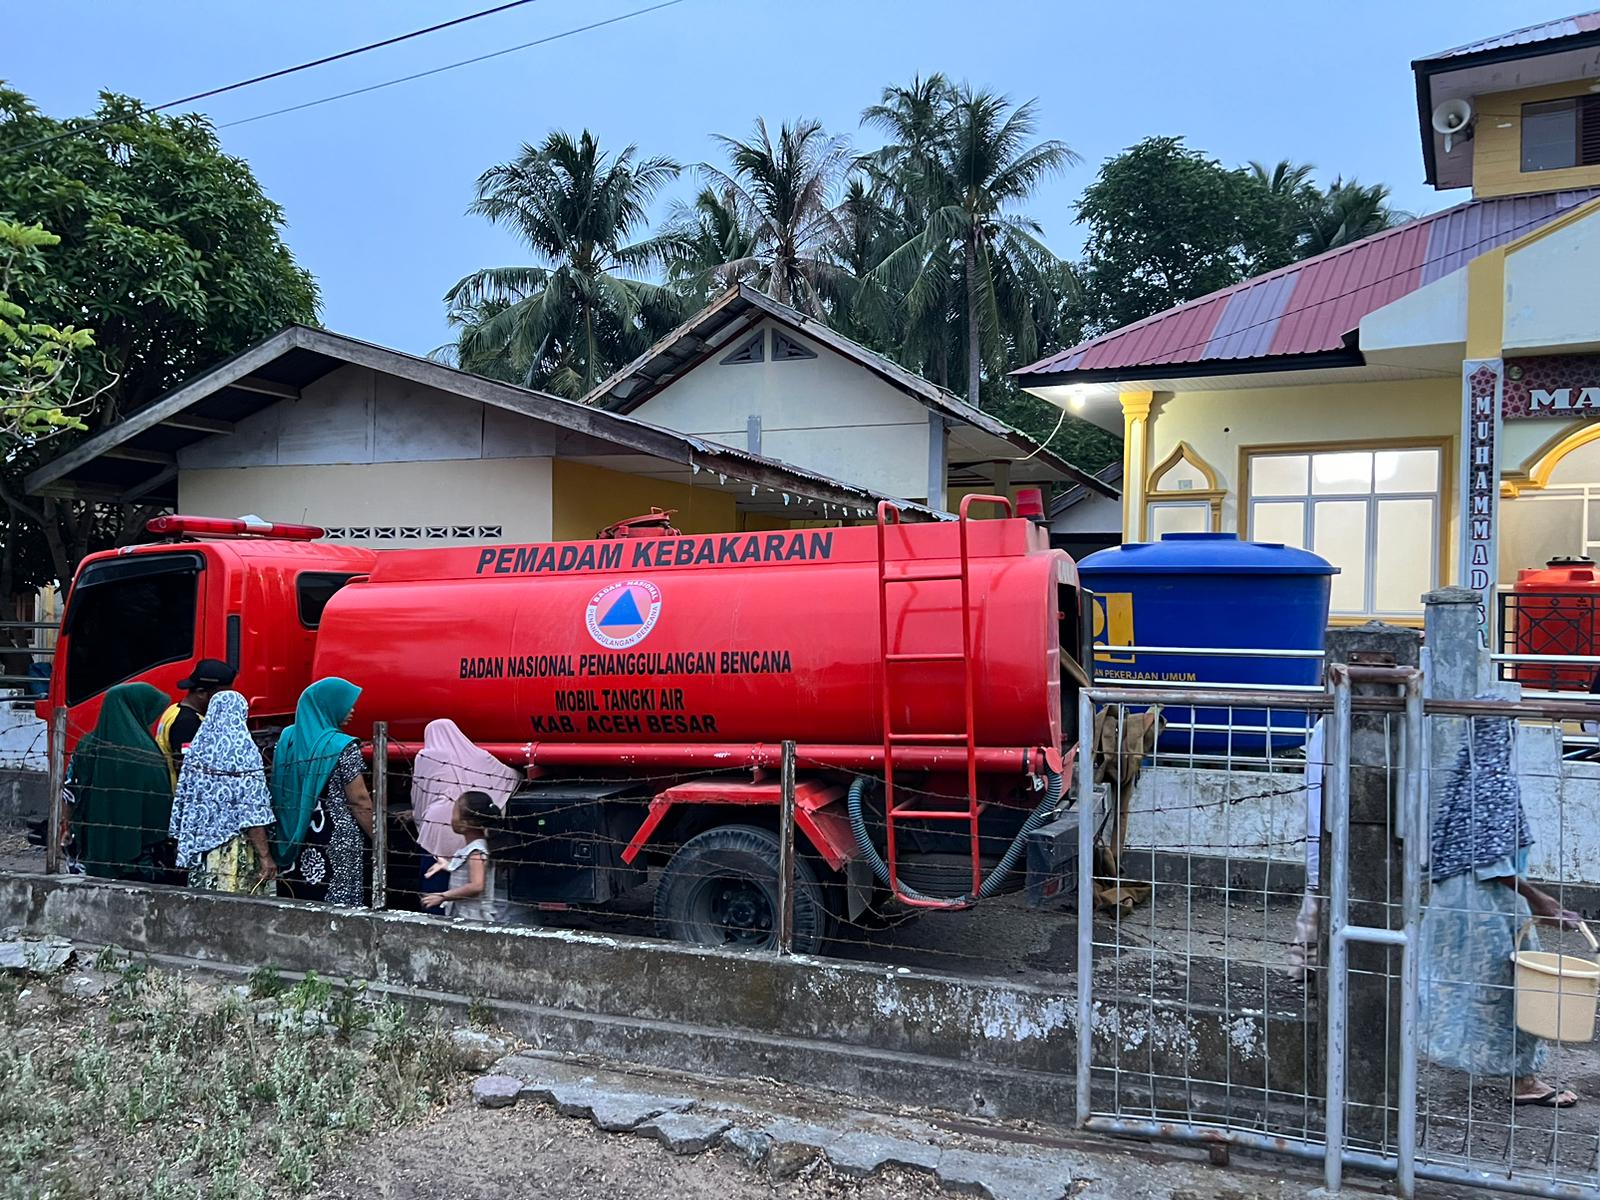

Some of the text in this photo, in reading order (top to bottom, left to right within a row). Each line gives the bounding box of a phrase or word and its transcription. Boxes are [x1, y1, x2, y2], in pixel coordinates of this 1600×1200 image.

[1471, 396, 1491, 590] MUHAMMAD
[475, 532, 834, 574] PEMADAM KEBAKARAN
[459, 650, 792, 679] BADAN NASIONAL PENANGGULANGAN BENCANA
[1104, 669, 1159, 681] PEKERJAAN
[1161, 672, 1197, 682] UMUM
[555, 688, 685, 712] MOBIL TANGKI AIR
[531, 714, 719, 734] KAB. ACEH BESAR
